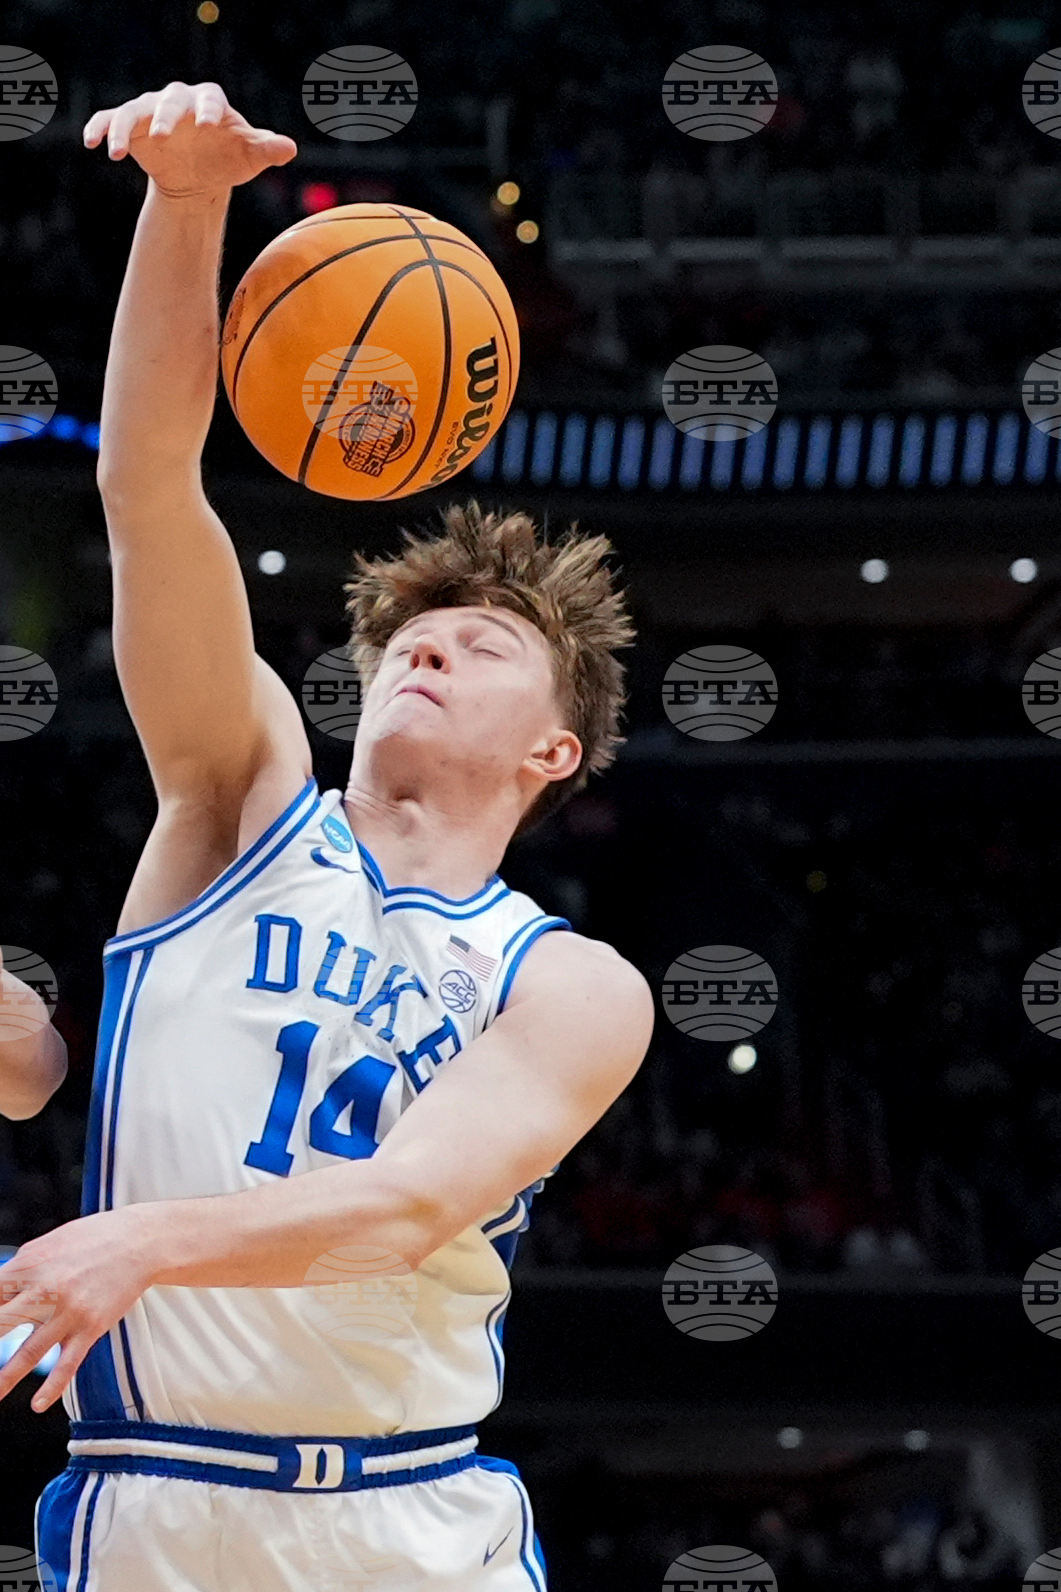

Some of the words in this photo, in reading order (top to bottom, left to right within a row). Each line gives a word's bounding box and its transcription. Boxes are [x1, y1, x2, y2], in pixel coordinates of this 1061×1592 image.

[415, 337, 498, 490] Wilso
[245, 913, 463, 1095] DUKE
[444, 982, 476, 1001] ACC
[244, 1020, 397, 1179] 14
[292, 1443, 345, 1489] D
